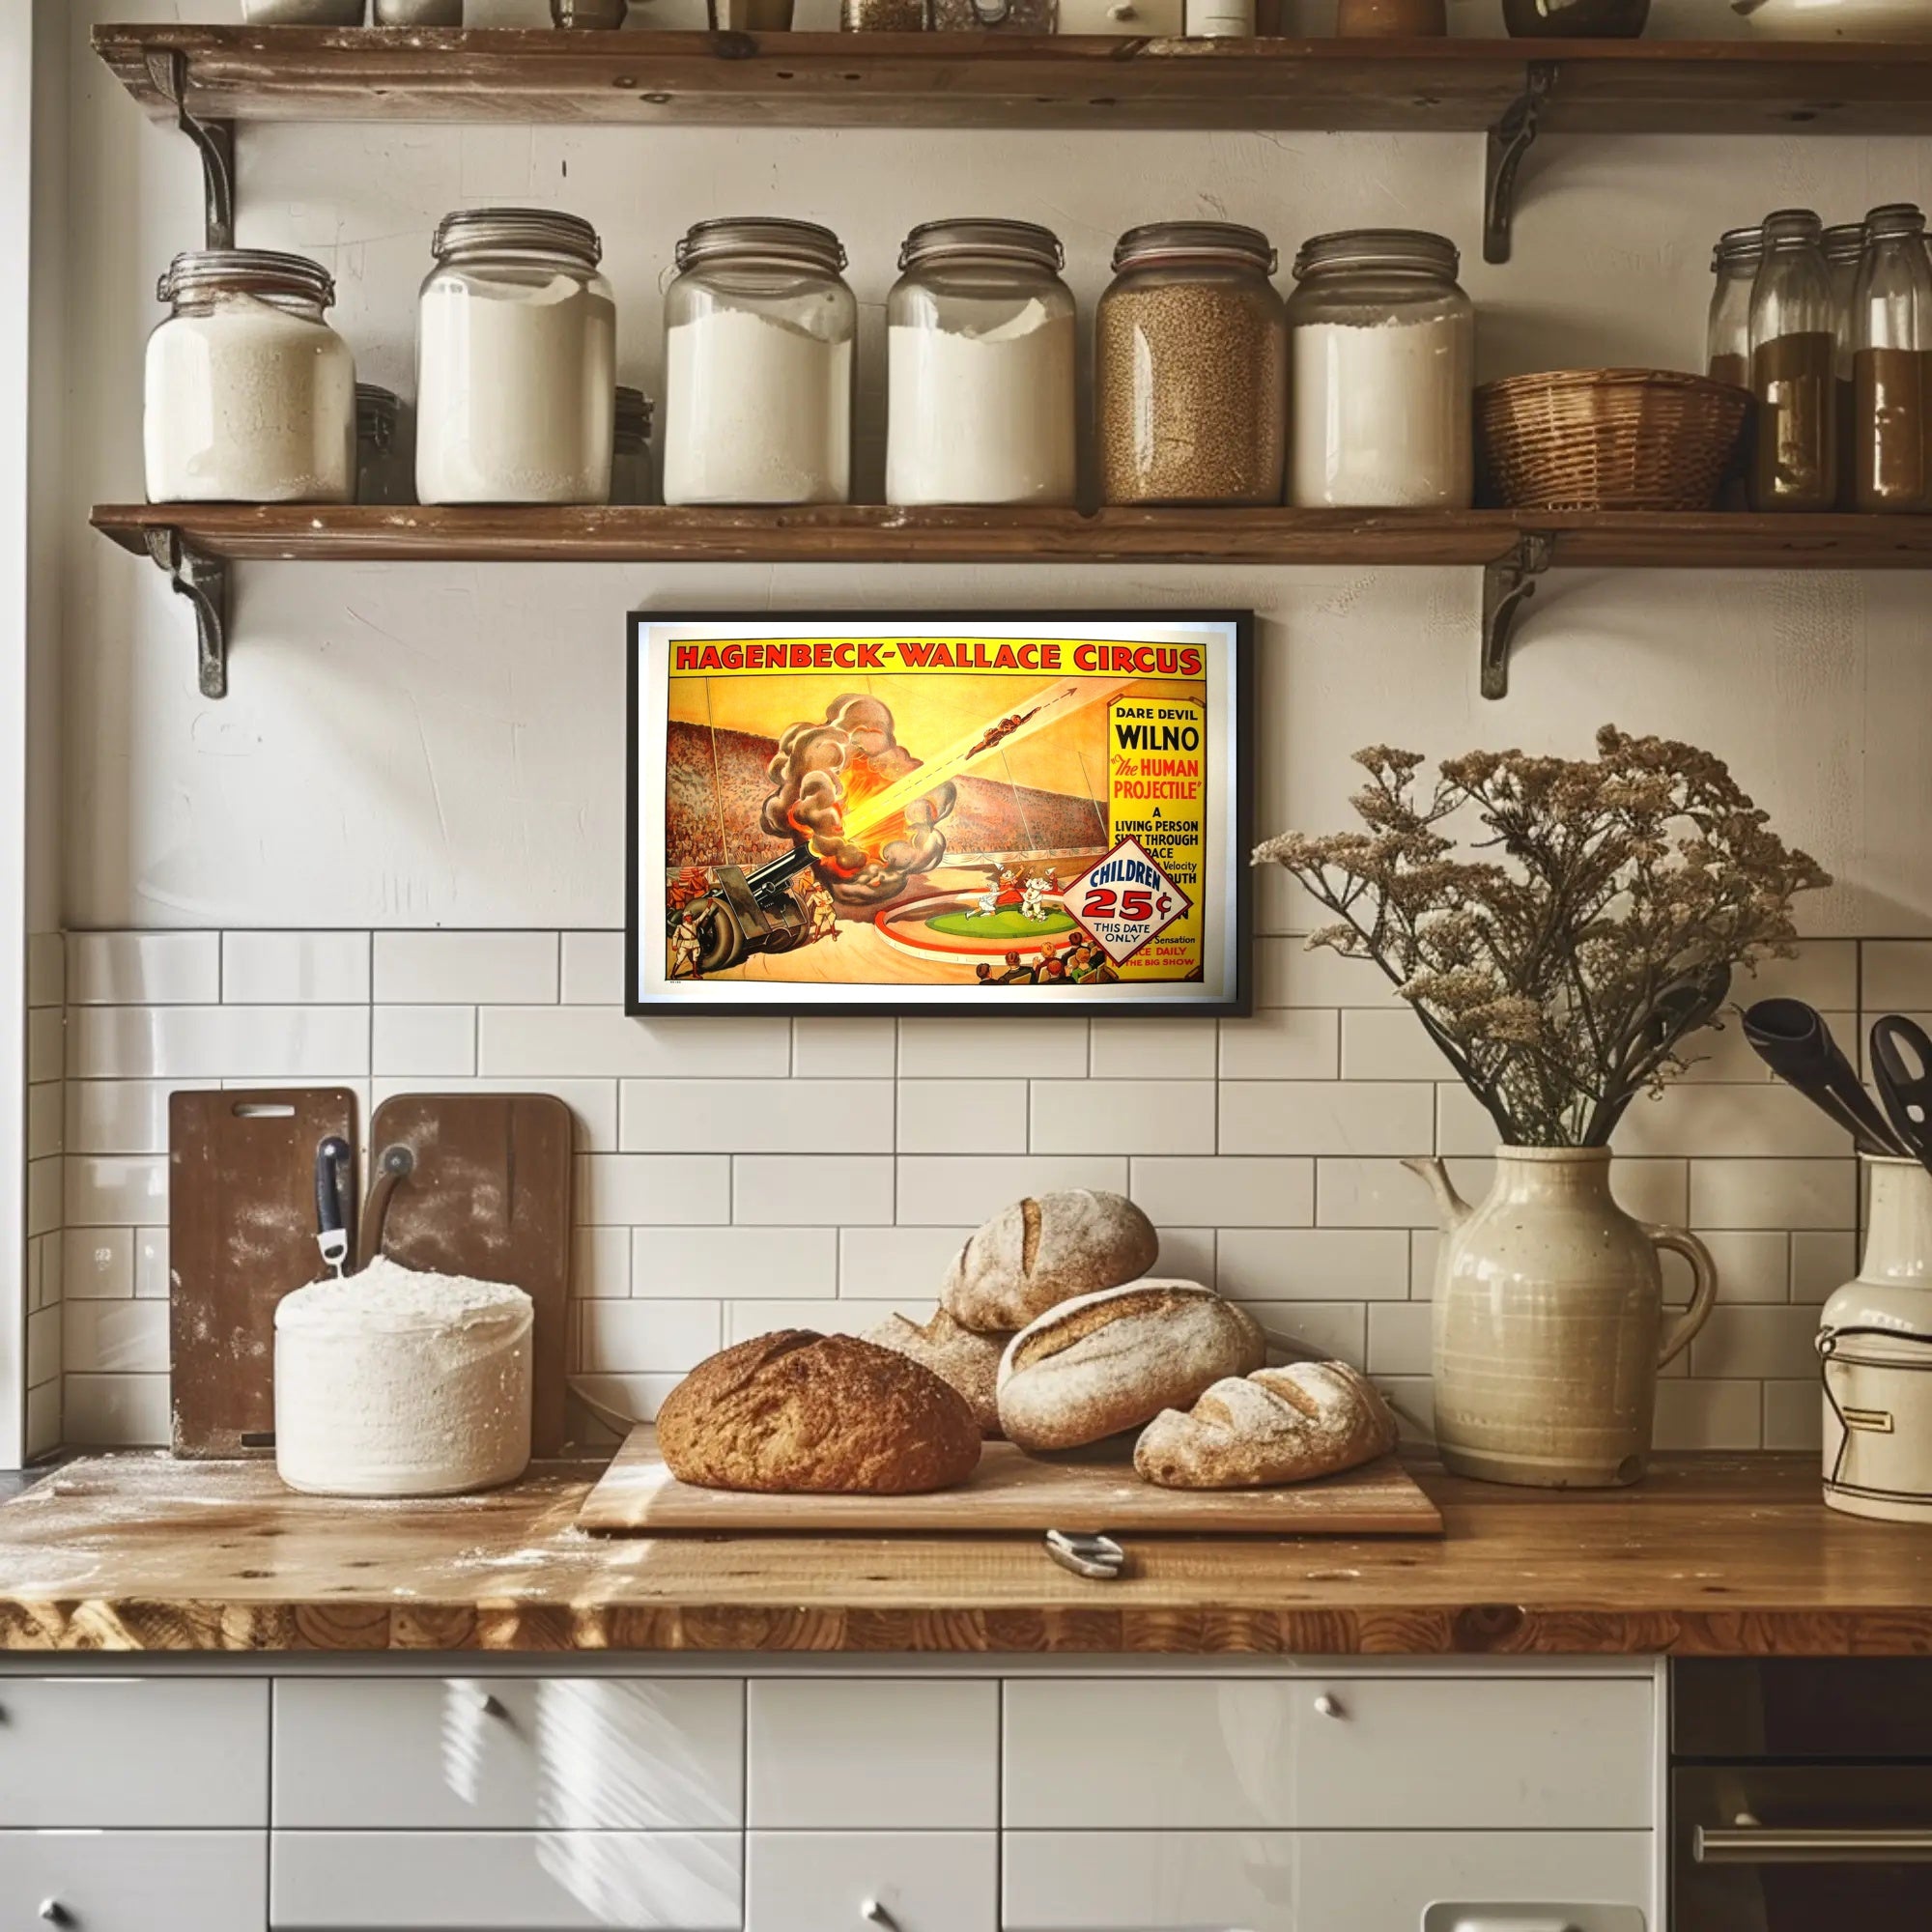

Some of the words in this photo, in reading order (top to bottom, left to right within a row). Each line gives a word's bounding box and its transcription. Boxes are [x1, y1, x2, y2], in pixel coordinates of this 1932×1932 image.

[676, 643, 1062, 669] HAGENBECK-WALLACE
[1073, 644, 1203, 675] CIRCUS
[1116, 707, 1153, 719] DARE
[1158, 709, 1198, 721] DEVIL
[1115, 724, 1200, 752] WILNO
[1141, 758, 1198, 777] HUMAN
[1152, 807, 1161, 817] A
[1115, 821, 1152, 832] LIVING
[1155, 821, 1198, 832] PERSON
[1115, 834, 1140, 845] ST
[1145, 834, 1198, 845] THROUGH
[1144, 847, 1174, 858] PACE
[1163, 861, 1197, 872] Velocity
[1090, 859, 1161, 892] CHILDREN
[1082, 889, 1173, 921] 25¢
[1094, 923, 1121, 933] THIS
[1123, 924, 1151, 933] DATE
[1105, 933, 1140, 943] ONLY
[1154, 936, 1195, 945] Sensation
[1156, 947, 1186, 955] DAILY
